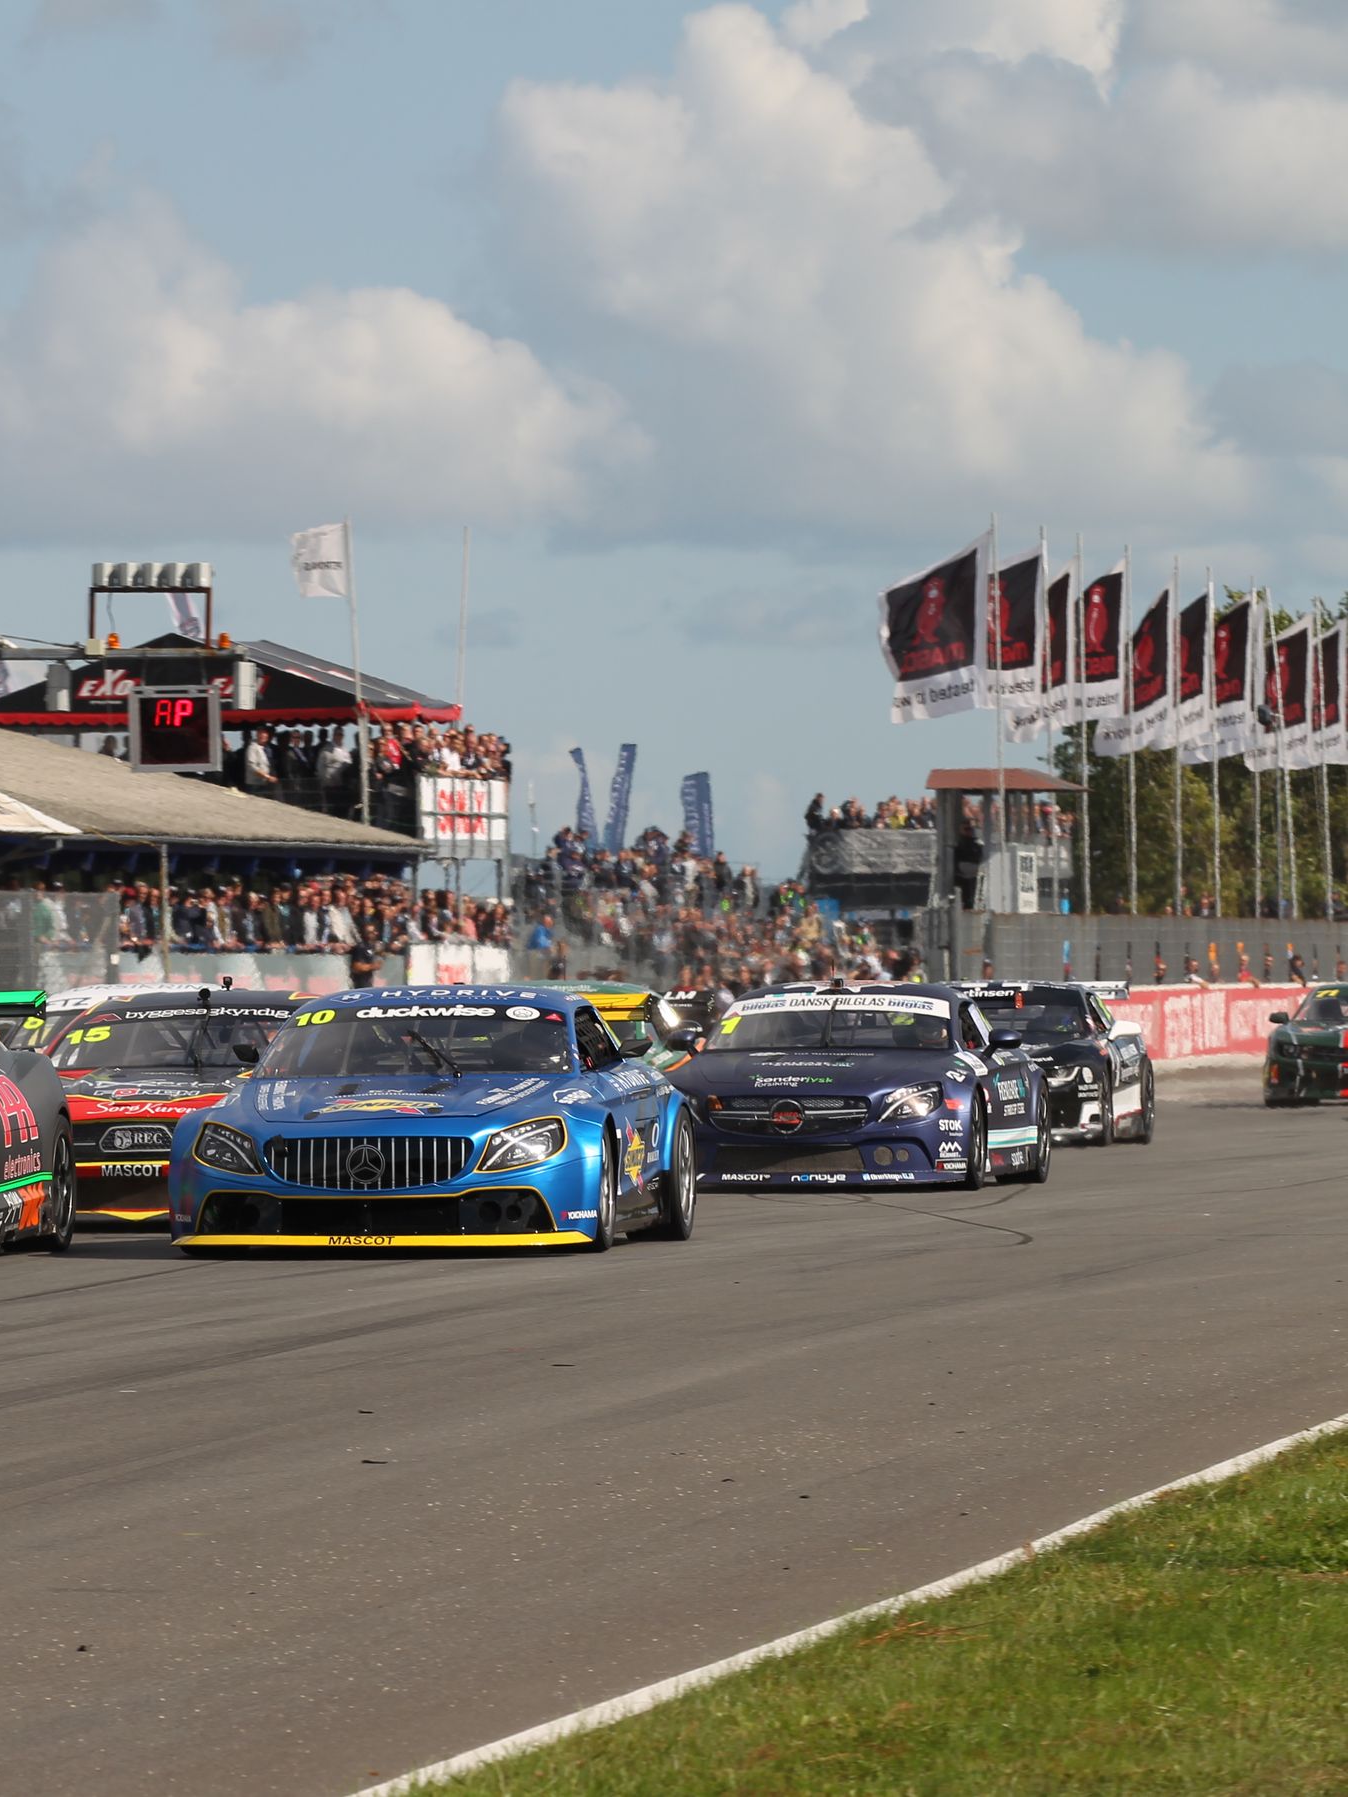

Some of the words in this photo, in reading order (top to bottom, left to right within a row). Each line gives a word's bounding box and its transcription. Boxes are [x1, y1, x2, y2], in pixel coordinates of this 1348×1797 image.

[963, 987, 1015, 998] rtinsen
[789, 997, 833, 1007] DANSK
[834, 997, 885, 1007] BILGLAS
[295, 1008, 336, 1028] 10
[355, 1004, 497, 1019] duckwise
[720, 1015, 743, 1035] 1
[65, 1025, 112, 1046] 15
[938, 1119, 964, 1132] STOK
[3, 1148, 42, 1182] electronics
[101, 1164, 162, 1178] MASCOT
[721, 1173, 765, 1182] MASCOT
[567, 1209, 598, 1220] YOKOHAMA
[327, 1235, 396, 1246] MASCOT
